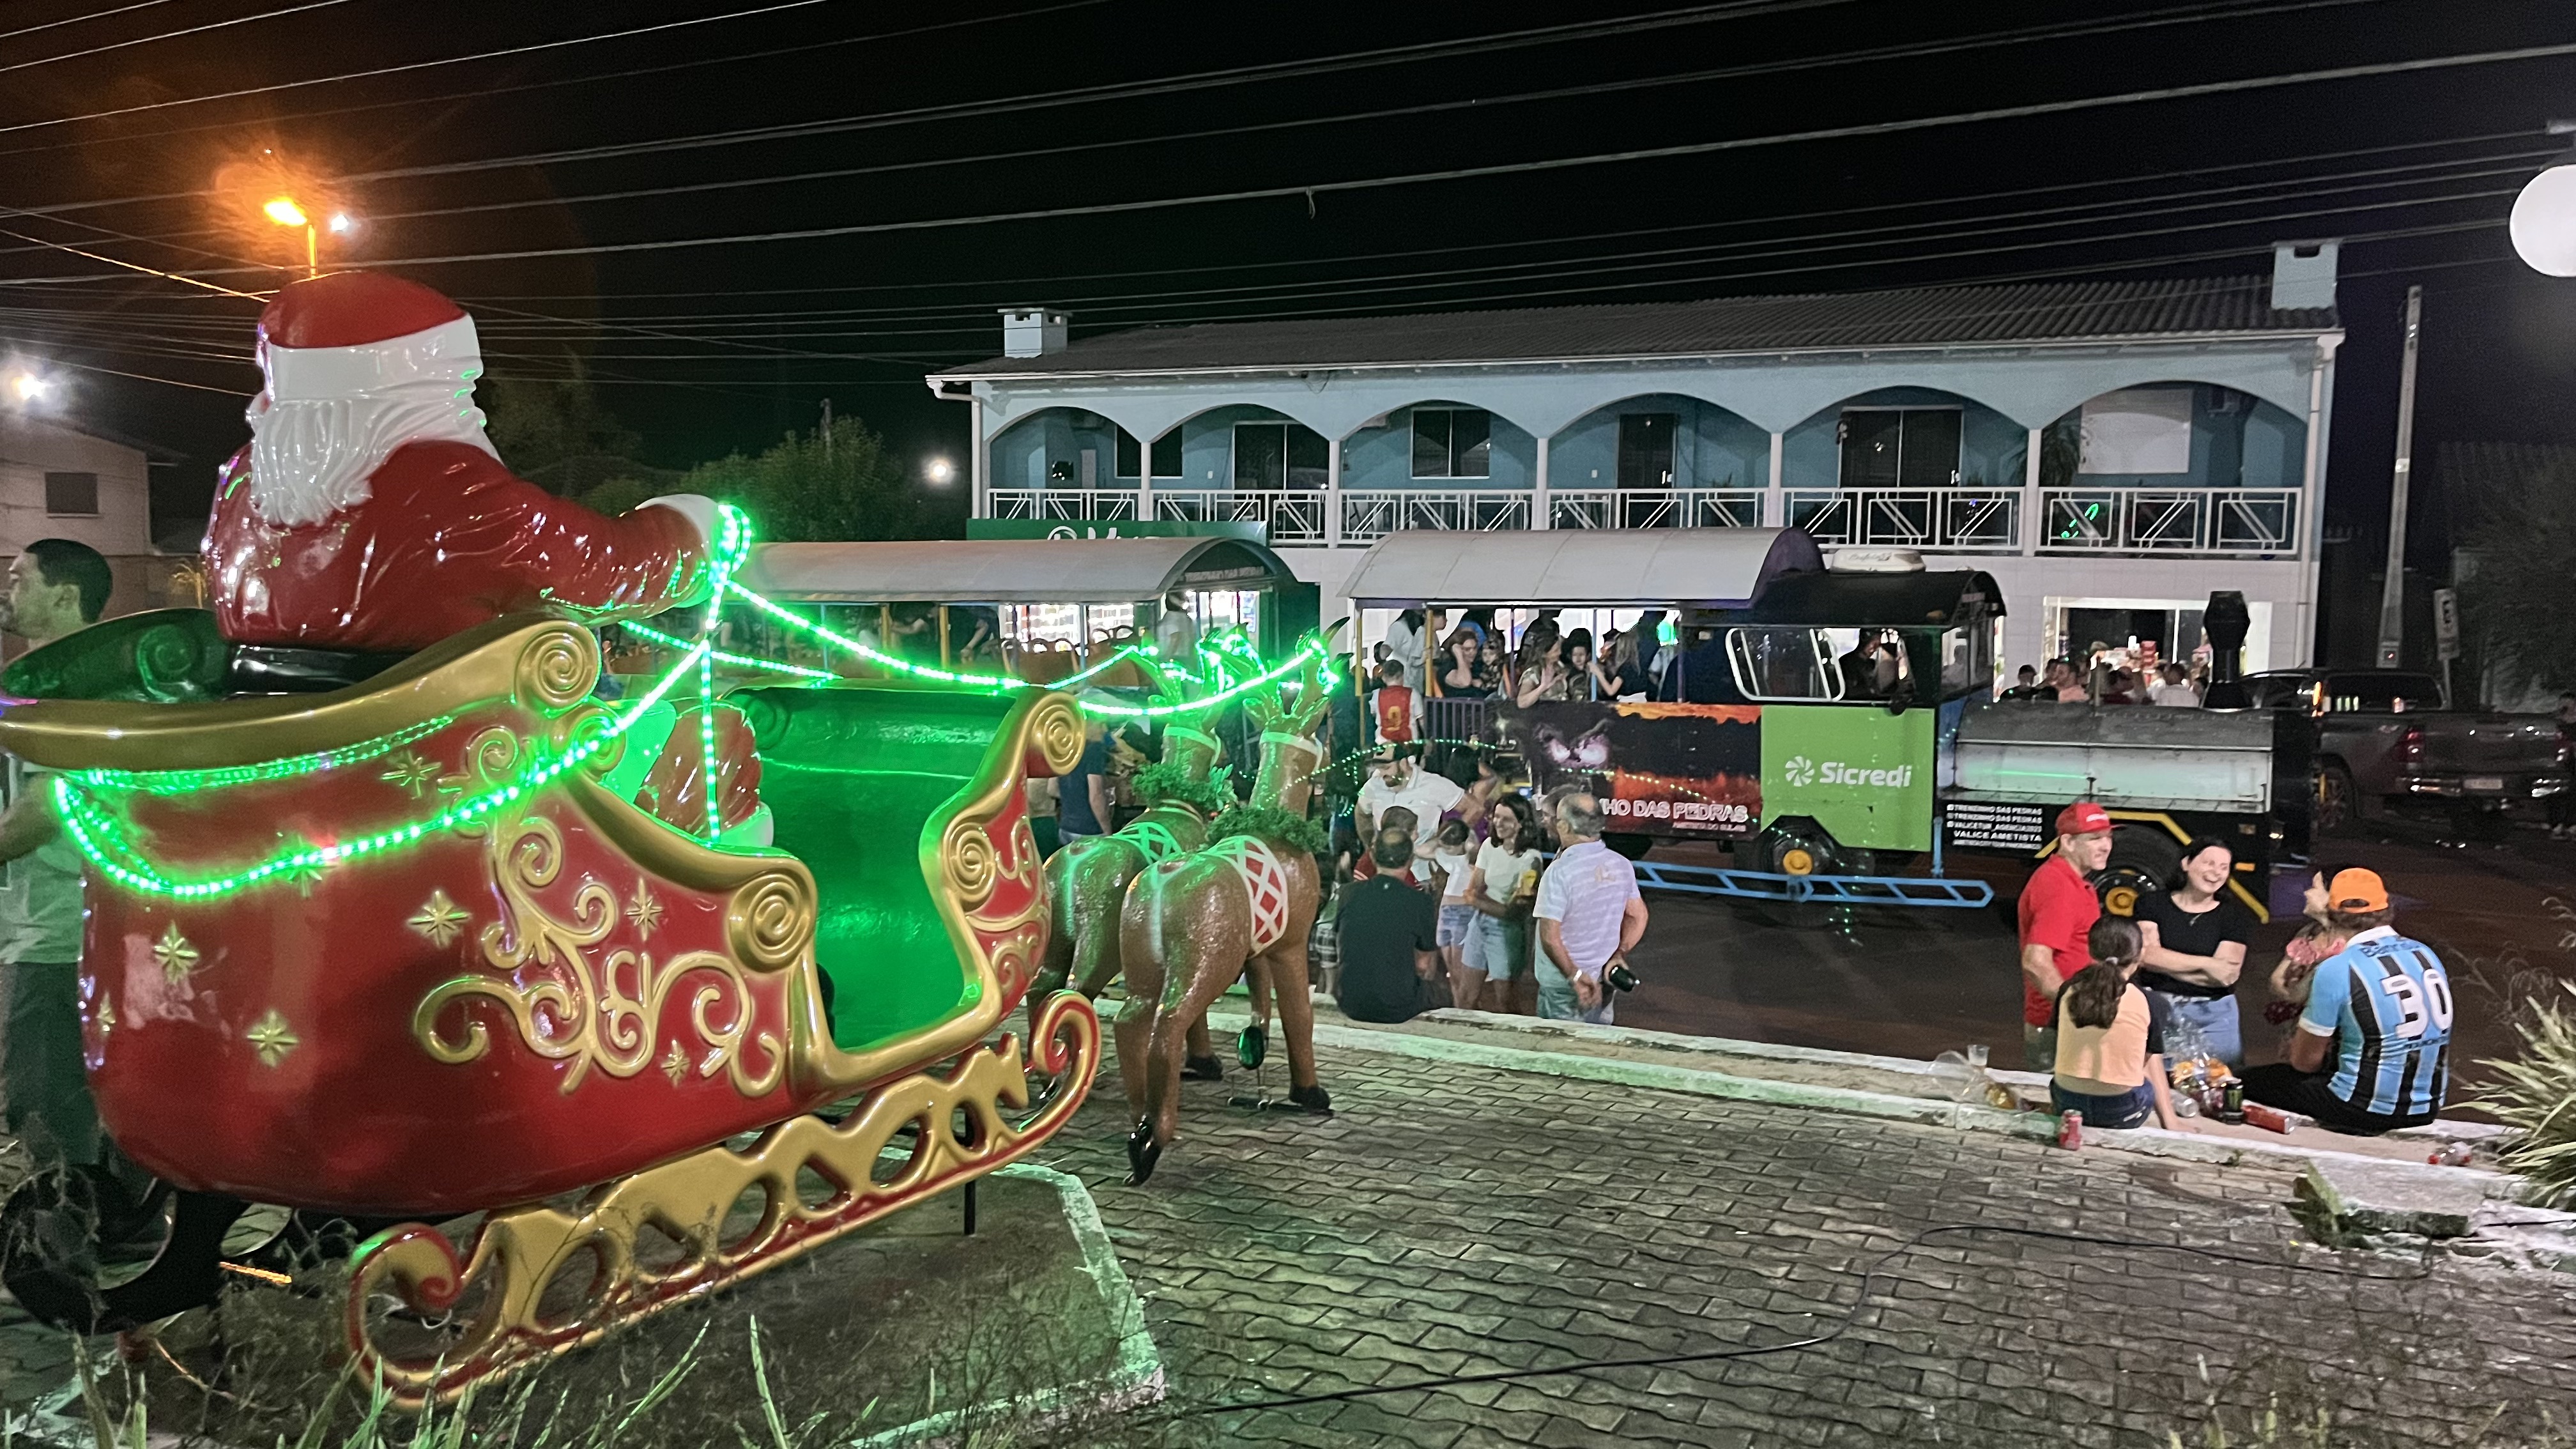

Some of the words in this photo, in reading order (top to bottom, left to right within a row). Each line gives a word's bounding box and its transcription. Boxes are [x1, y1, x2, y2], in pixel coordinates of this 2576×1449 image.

[1388, 706, 1401, 732] 9
[1819, 762, 1912, 787] Sicredi
[1633, 800, 1670, 818] DAS
[1673, 802, 1749, 822] PEDRAS
[1990, 832, 2042, 841] AMETISTA
[2381, 969, 2453, 1039] 30
